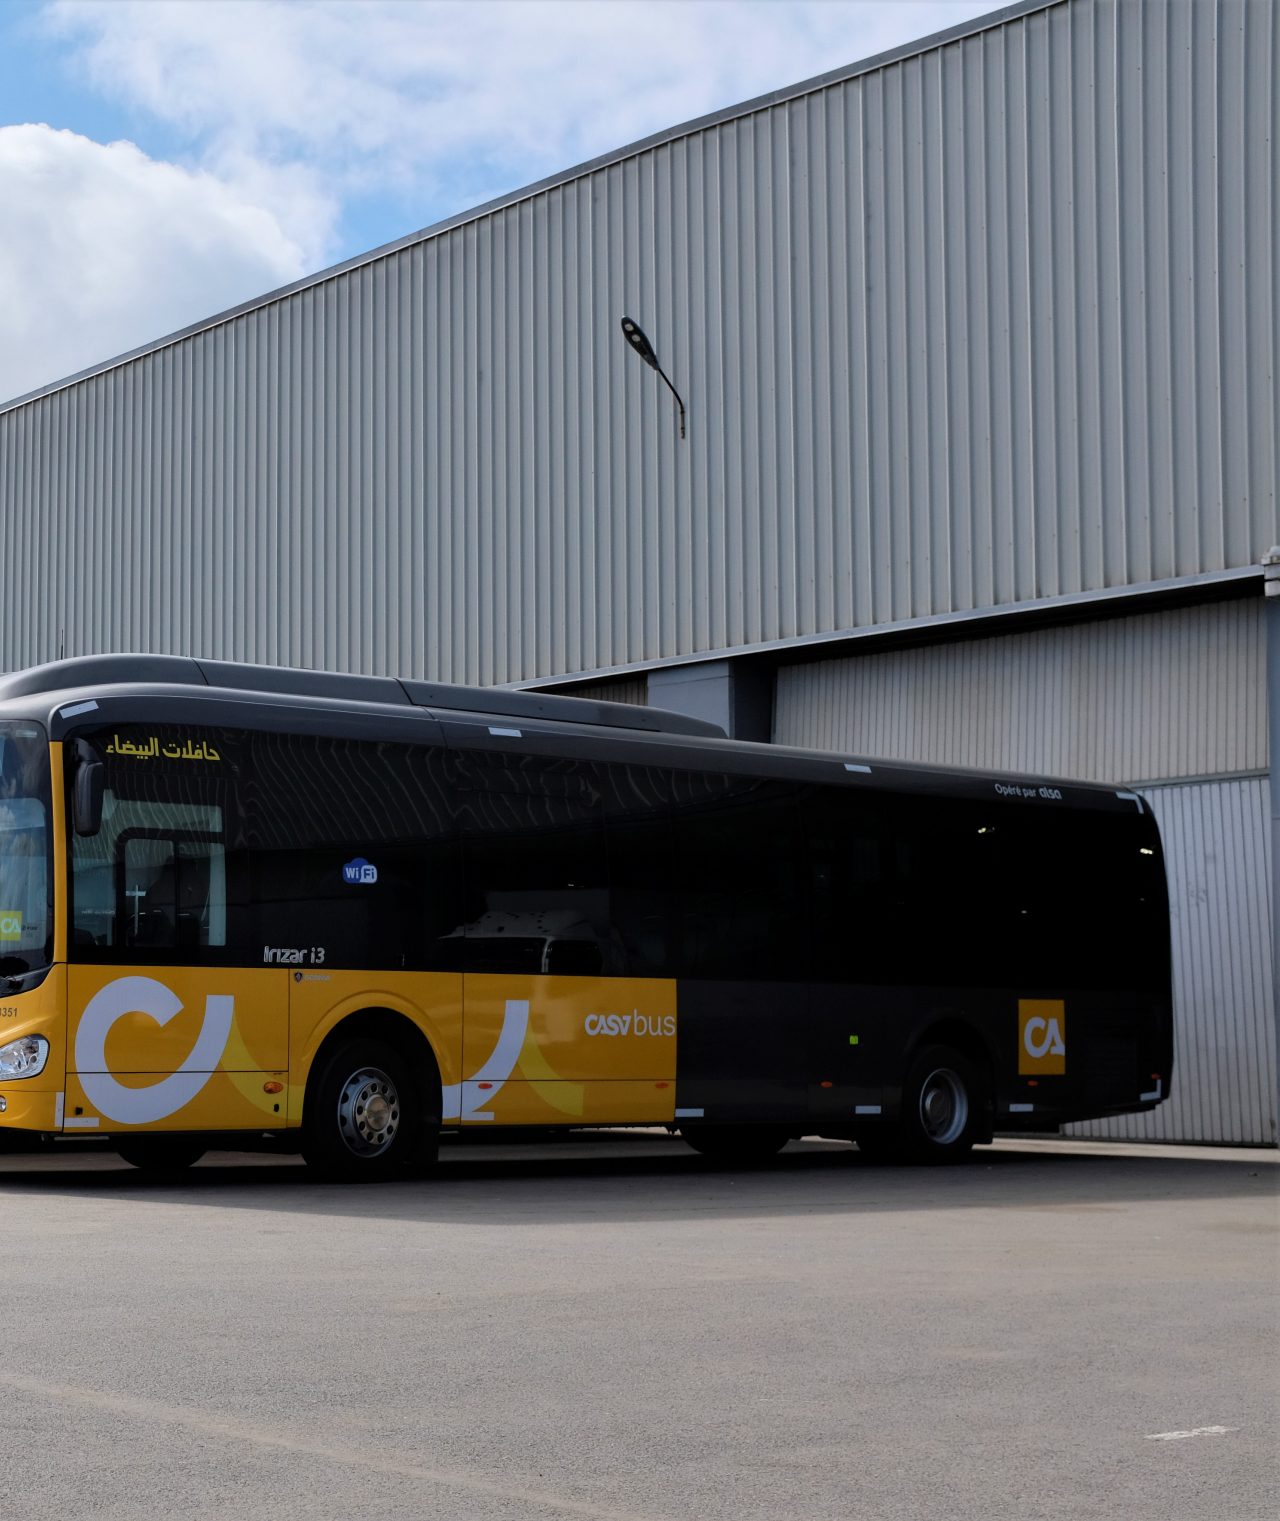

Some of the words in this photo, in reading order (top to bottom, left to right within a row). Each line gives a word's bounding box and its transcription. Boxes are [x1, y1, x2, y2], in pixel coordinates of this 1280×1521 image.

[106, 734, 159, 760] البيضاء
[162, 740, 220, 761] حافلات
[995, 784, 1022, 796] Opéré
[1023, 788, 1036, 798] par
[1039, 786, 1062, 799] alsa
[263, 946, 308, 963] Irizar
[310, 947, 326, 964] i3
[1024, 1016, 1066, 1058] CA
